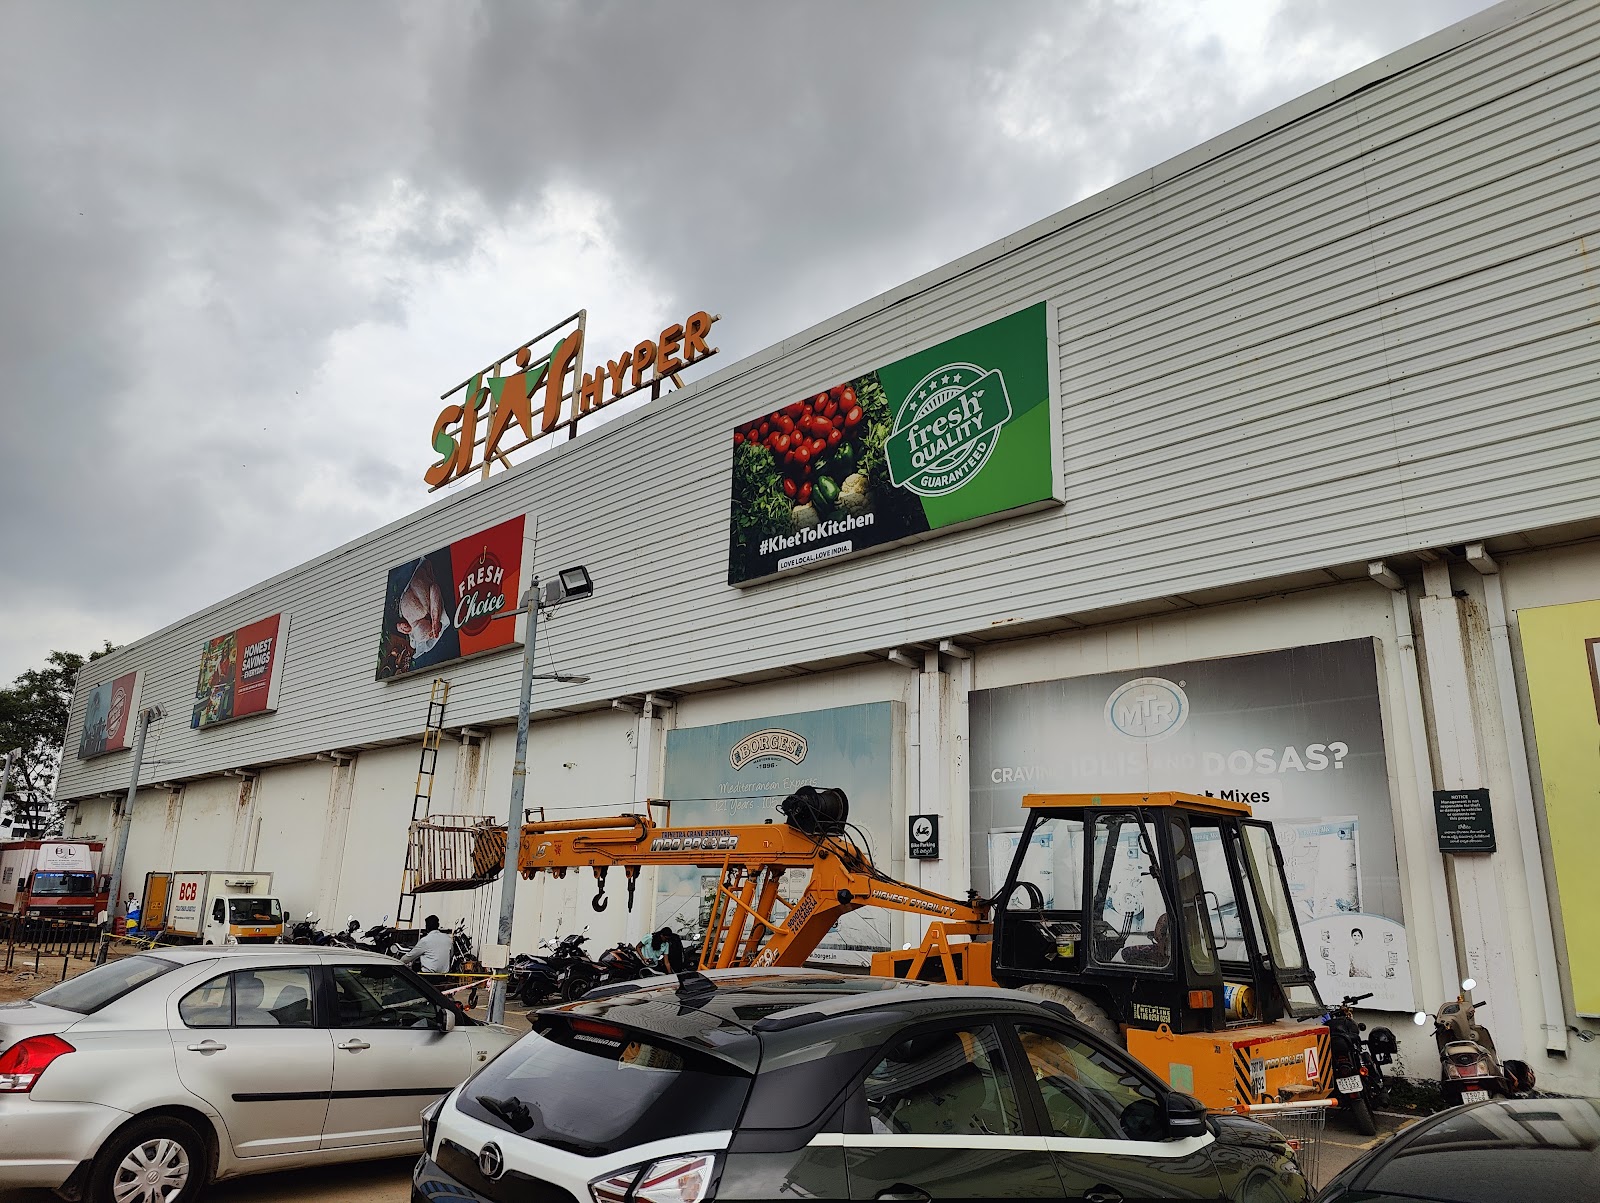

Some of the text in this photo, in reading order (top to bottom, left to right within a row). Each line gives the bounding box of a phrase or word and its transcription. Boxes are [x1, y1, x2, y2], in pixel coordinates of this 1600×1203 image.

[580, 311, 712, 413] HYPER
[907, 392, 983, 454] fresh
[911, 412, 984, 468] QUALITY
[920, 442, 987, 488] GUARANTEED
[759, 512, 875, 556] #KhetToKitchen
[780, 560, 795, 569] LOVE
[815, 551, 831, 560] LOVE
[831, 545, 850, 556] INDIA.
[458, 565, 504, 598] FRESH
[454, 591, 506, 629] Choice
[244, 637, 273, 659] HONEST
[242, 651, 271, 672] SAVINGS
[1120, 694, 1174, 728] MTR
[740, 735, 797, 760] BORGES
[1203, 741, 1349, 776] DOSAS?
[718, 781, 780, 794] Mediterranean
[1220, 789, 1271, 804] Mixes
[730, 799, 754, 816] Years
[651, 838, 681, 852] INDO
[179, 882, 198, 901] BCB
[872, 890, 957, 916] HIGHEST STABILITY
